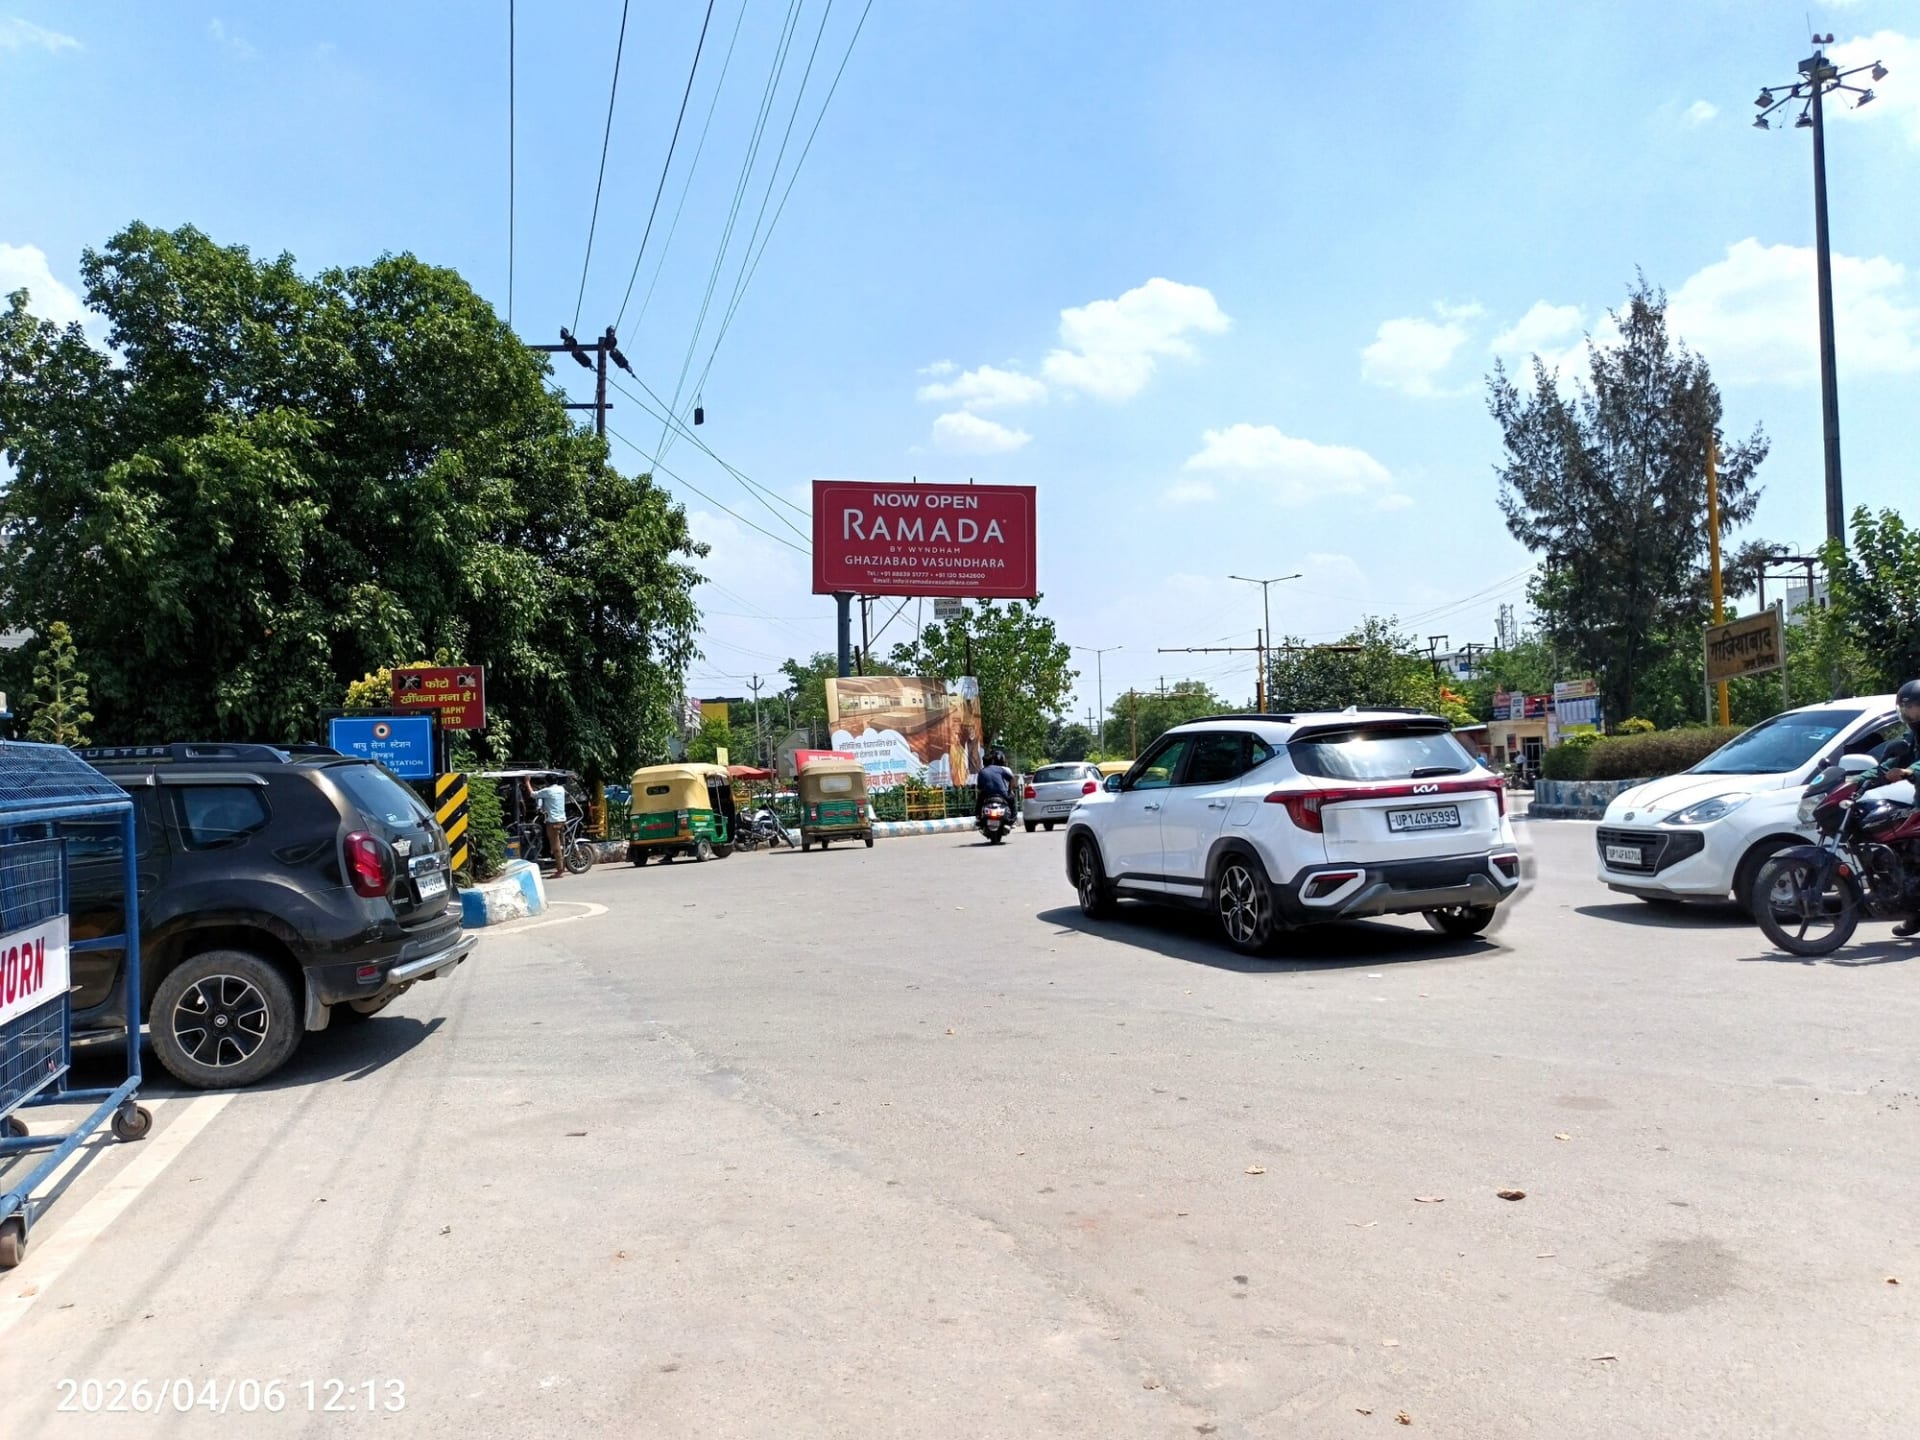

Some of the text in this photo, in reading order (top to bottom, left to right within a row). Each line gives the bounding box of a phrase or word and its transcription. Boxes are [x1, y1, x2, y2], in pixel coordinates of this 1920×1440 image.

[873, 493, 979, 509] NOW OPEN
[843, 508, 1005, 544] RAMADA
[908, 546, 961, 554] WYNDHAM
[844, 555, 1005, 568] GHAZIABAD VASUNDHARA
[425, 678, 449, 689] फोटो
[438, 693, 460, 703] मना
[370, 740, 386, 749] सेना
[389, 759, 424, 767] STATION
